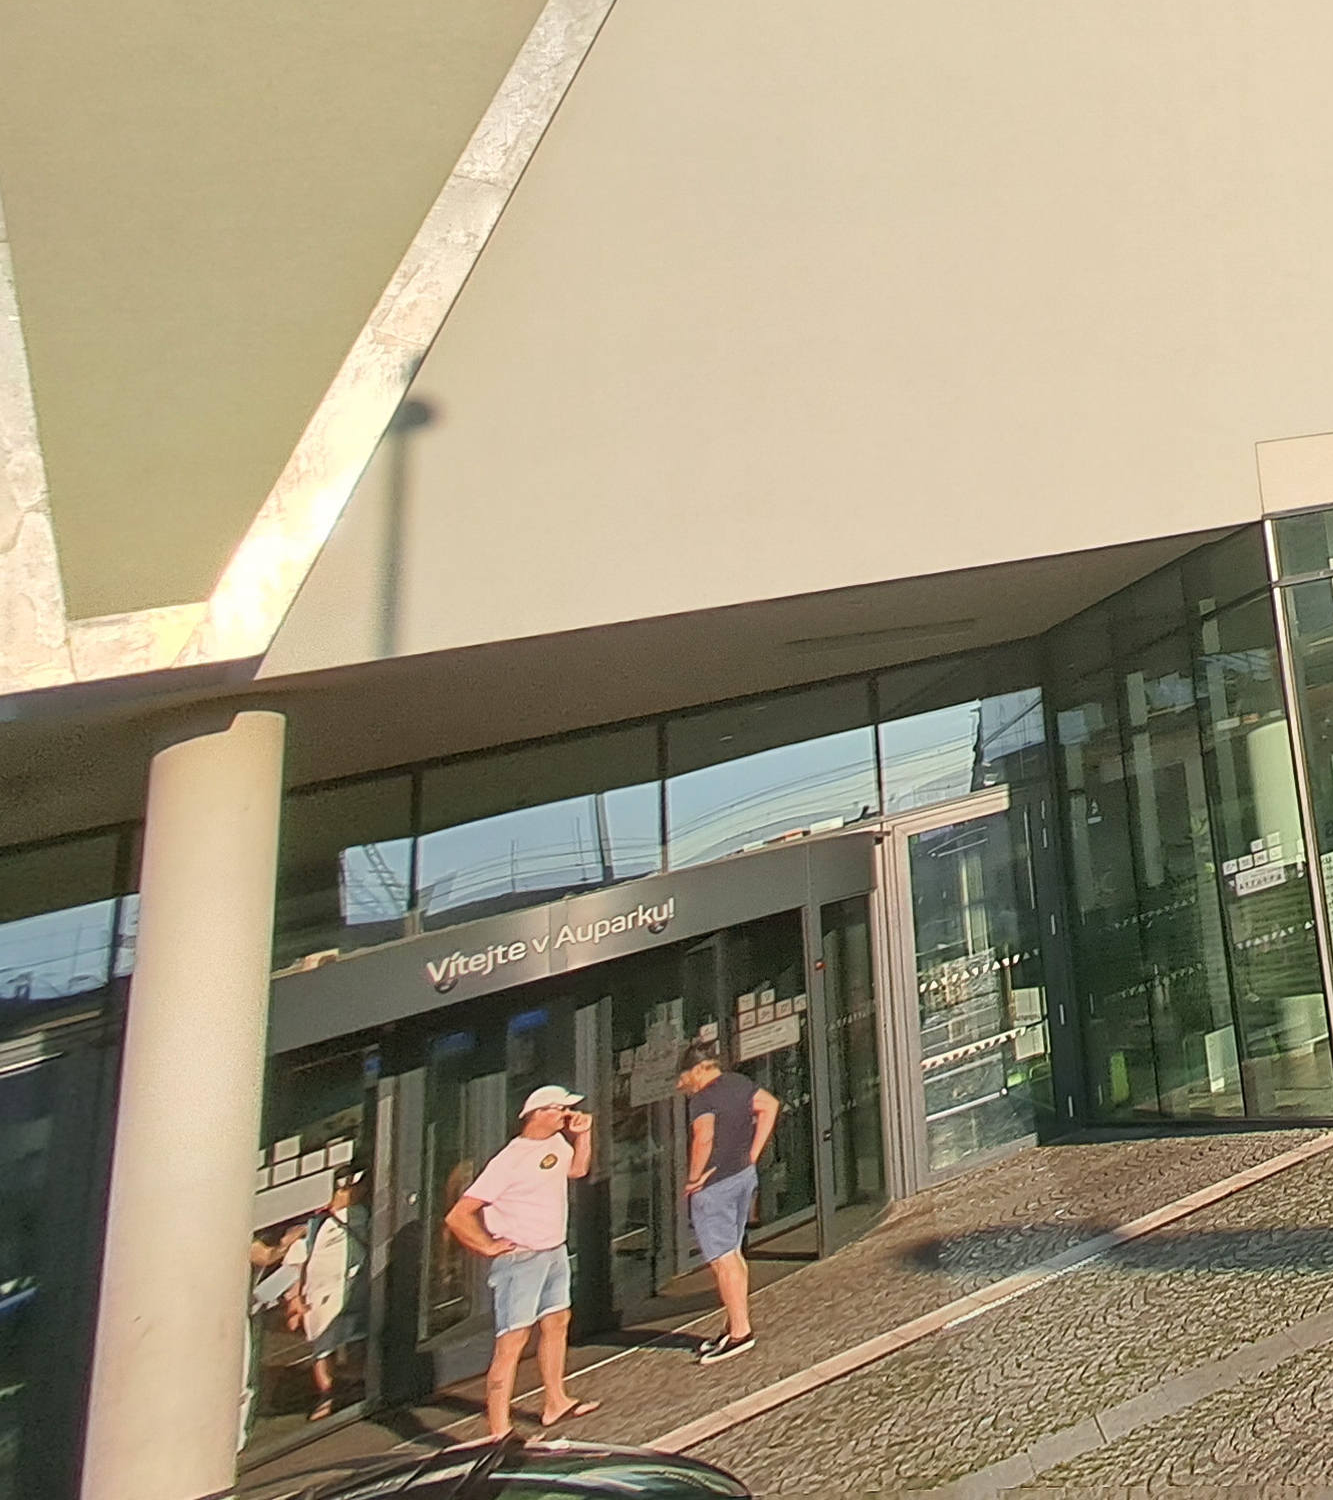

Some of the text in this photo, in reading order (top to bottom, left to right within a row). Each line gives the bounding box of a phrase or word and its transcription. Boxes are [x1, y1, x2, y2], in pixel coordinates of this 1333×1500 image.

[427, 897, 675, 982] Vítejte v Auparku!
